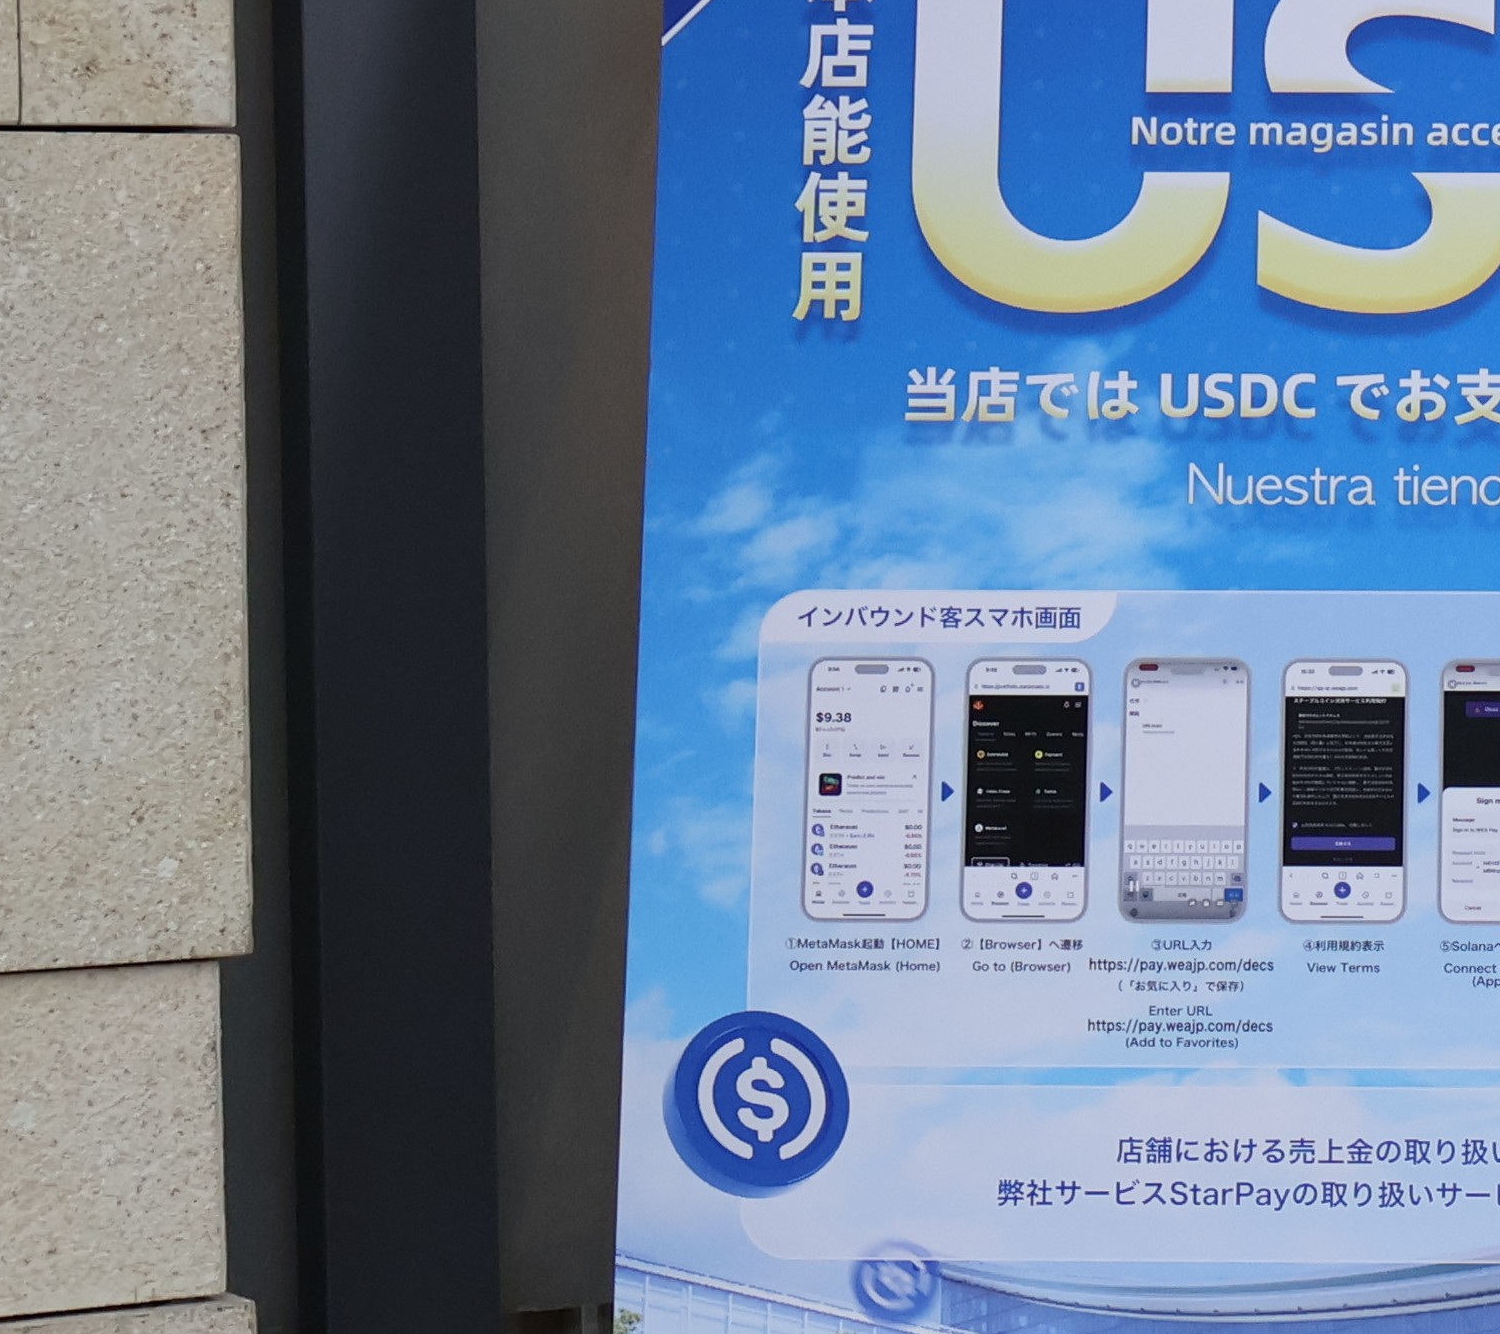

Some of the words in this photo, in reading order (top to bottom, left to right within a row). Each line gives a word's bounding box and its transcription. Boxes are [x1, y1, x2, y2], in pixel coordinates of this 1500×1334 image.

[1131, 116, 1237, 146] Notre
[1249, 114, 1414, 154] magasin
[904, 367, 1140, 424] 当店では
[1160, 372, 1317, 419] USDC
[1188, 462, 1377, 507] Nuestra
[797, 605, 1082, 632] インバウンド客スマホ画面
[816, 711, 852, 723] $9.38
[1476, 797, 1494, 805] Sign
[789, 959, 823, 973] Open
[826, 960, 891, 971] MetaMask
[895, 960, 941, 973] (Home)
[972, 960, 990, 972] Go
[993, 962, 1006, 972] to
[1010, 961, 1071, 973] (Browser)
[1088, 957, 1275, 974] https://pay.weajp.com/decs
[1306, 962, 1337, 973] View
[1340, 962, 1381, 973] Terms
[1443, 962, 1497, 974] Connect
[1148, 1005, 1183, 1017] Enter
[1186, 1005, 1213, 1017] URL
[1087, 1018, 1274, 1035] https://pay.weajp.com/decs
[1125, 1037, 1156, 1049] (Add
[1160, 1038, 1173, 1048] to
[1176, 1037, 1239, 1049] Favorites)
